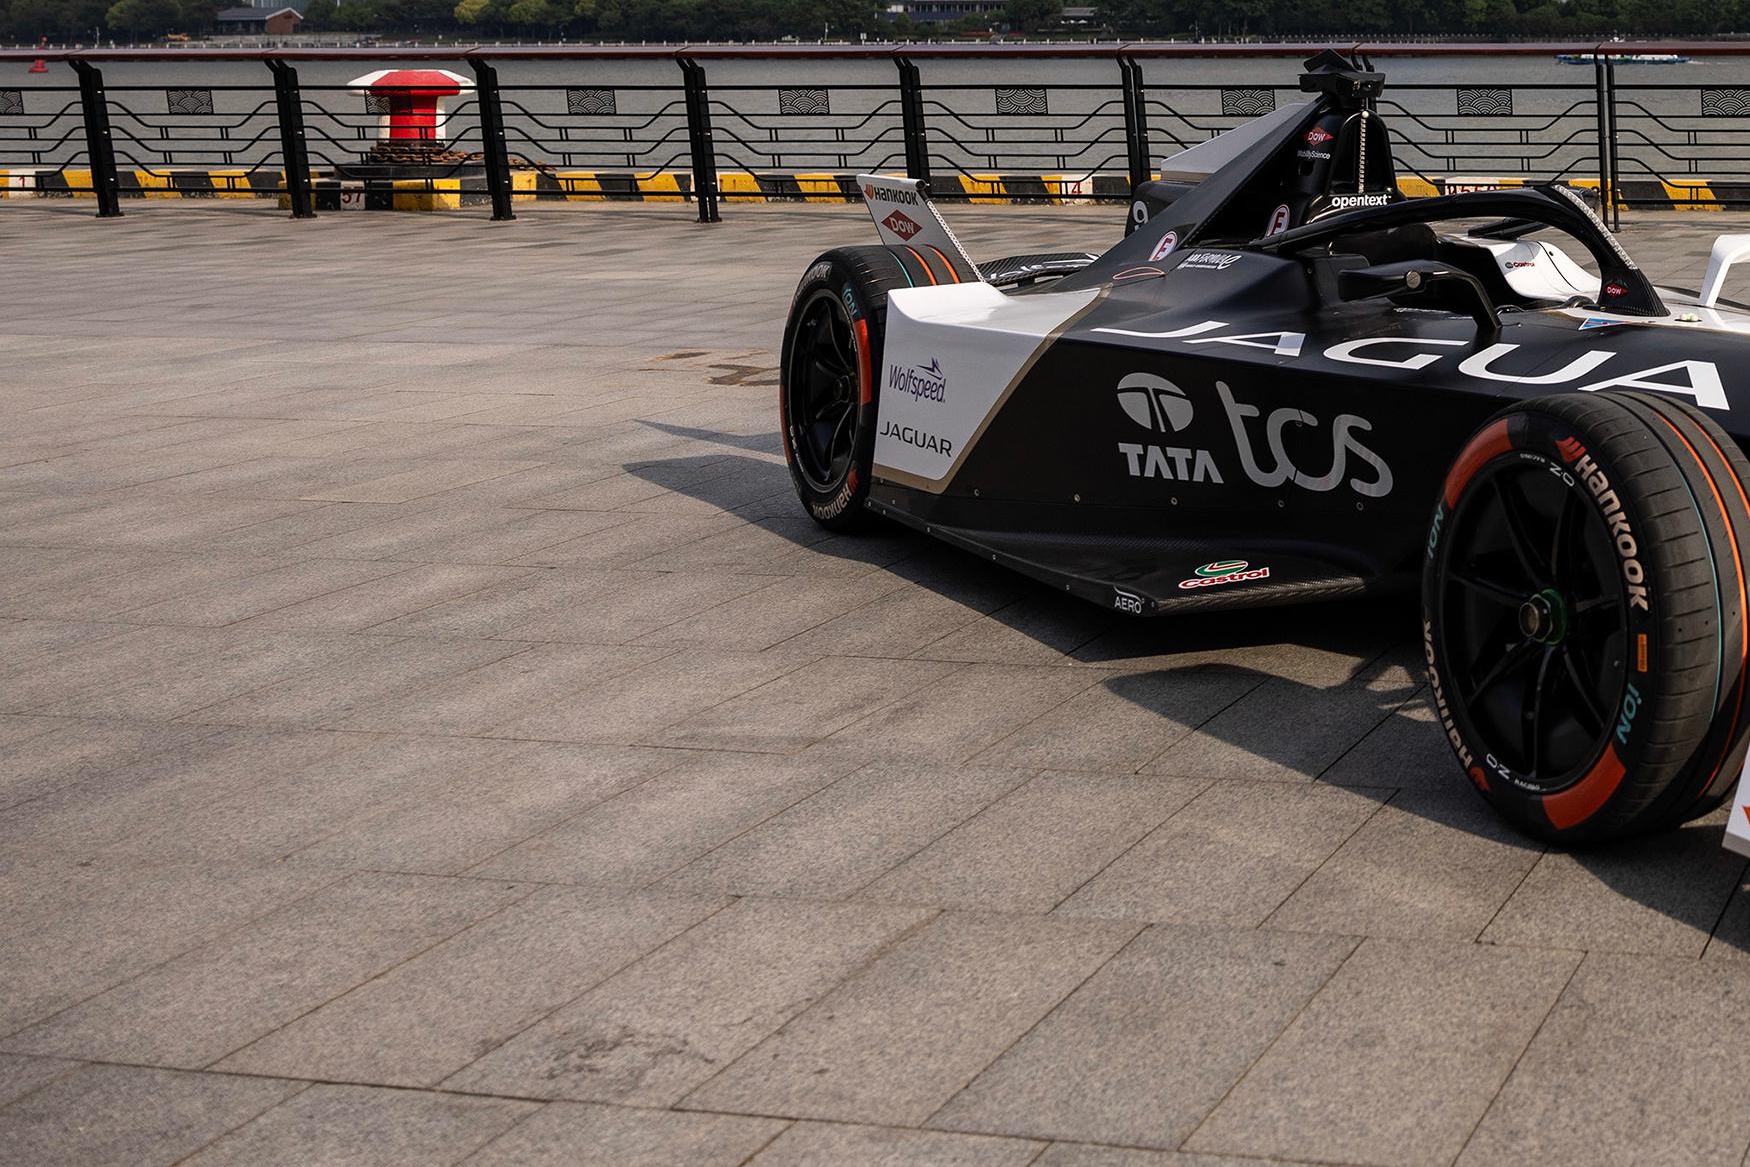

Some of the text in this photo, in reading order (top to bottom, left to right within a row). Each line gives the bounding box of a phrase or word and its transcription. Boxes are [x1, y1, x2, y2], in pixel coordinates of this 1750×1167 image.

[879, 424, 953, 459] JAGUAR
[1118, 381, 1394, 498] TATA tcs
[1177, 566, 1270, 590] Castrol
